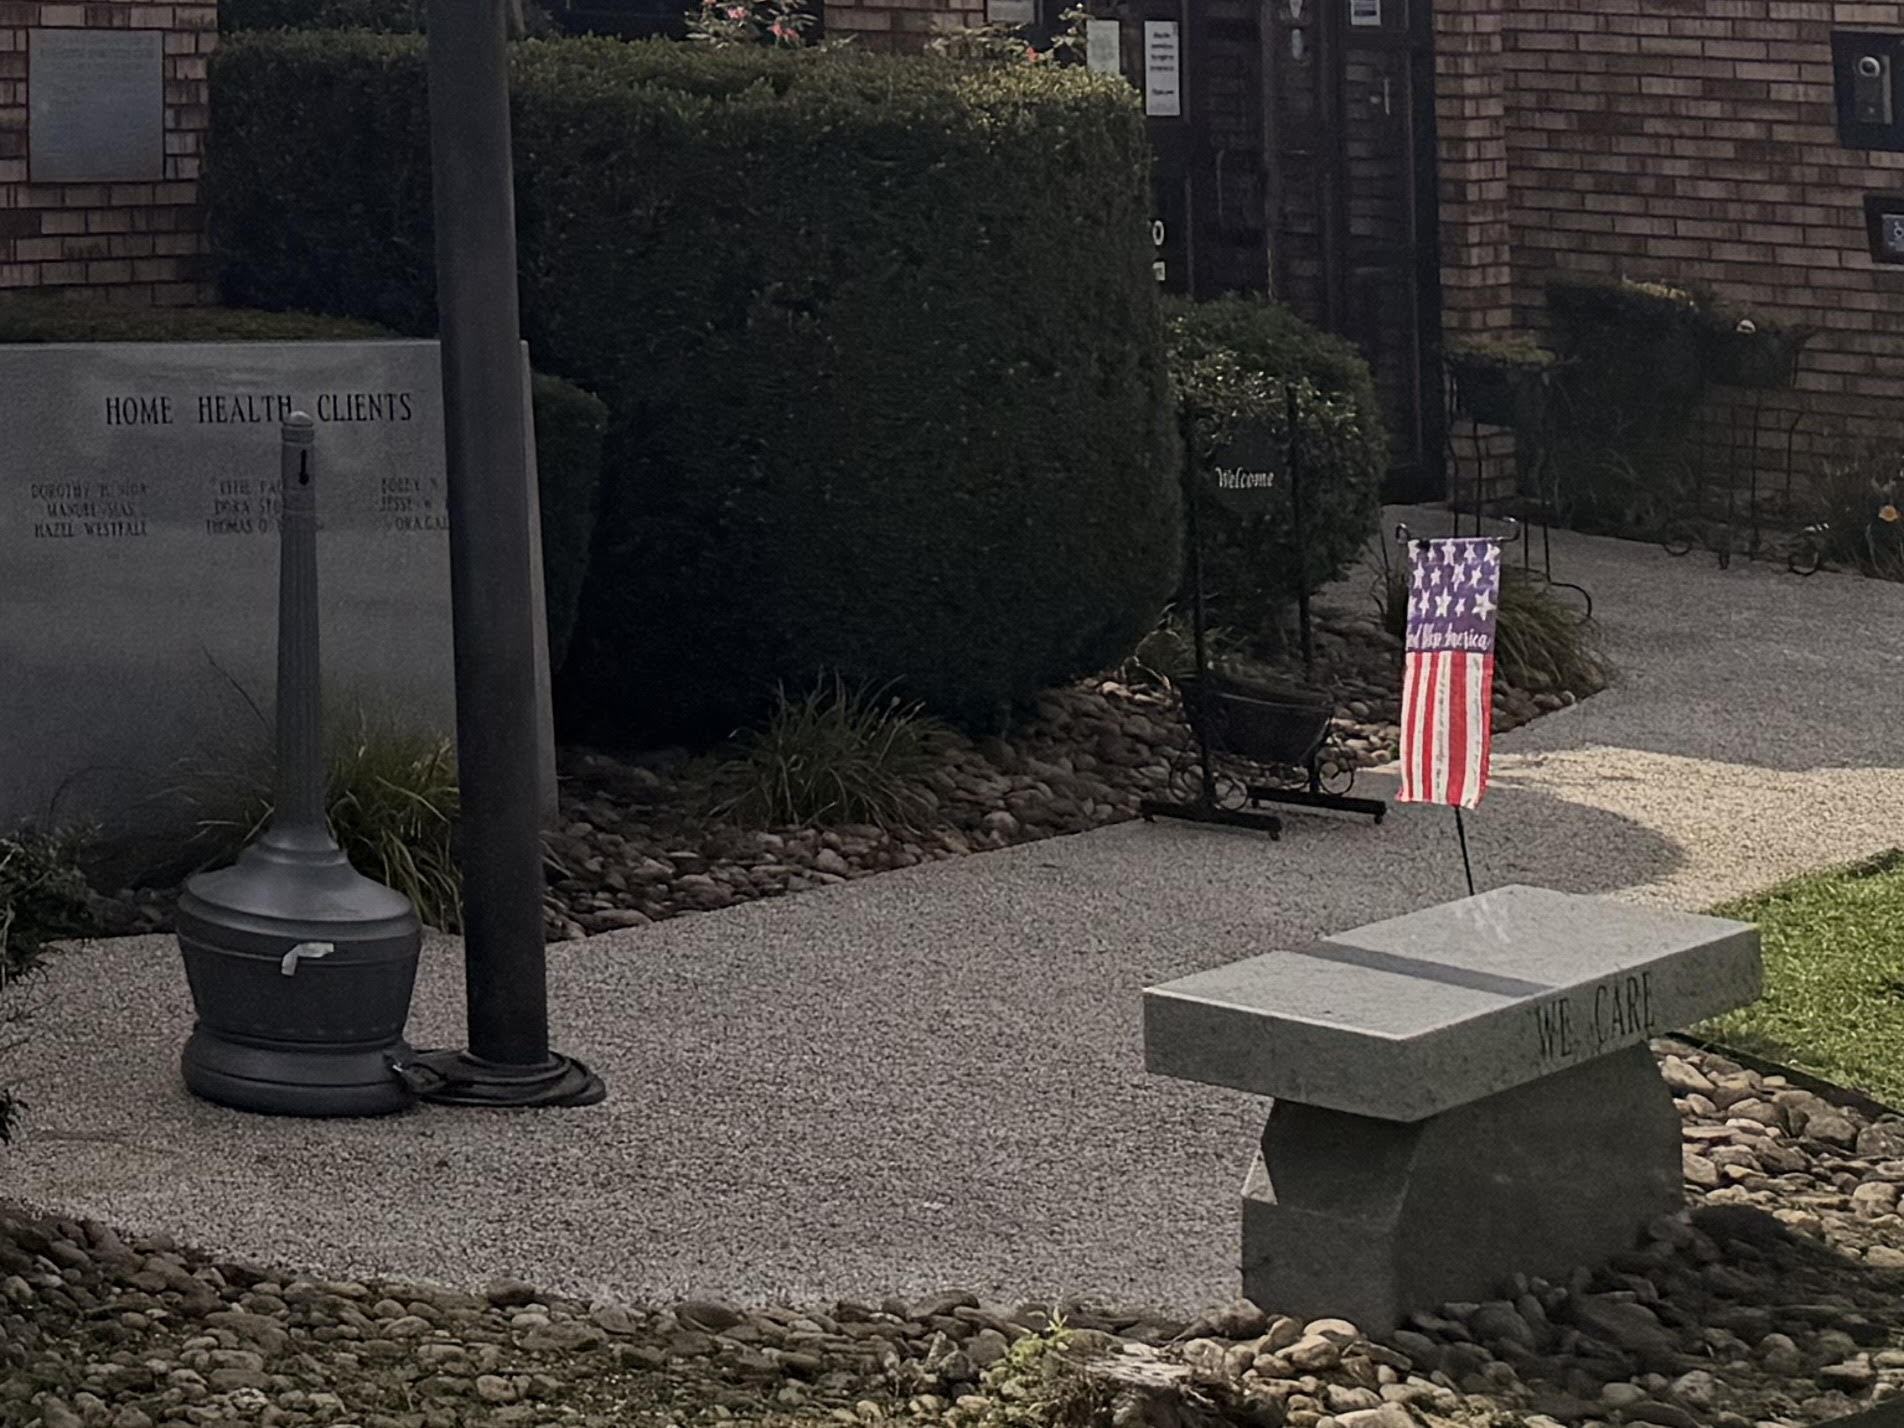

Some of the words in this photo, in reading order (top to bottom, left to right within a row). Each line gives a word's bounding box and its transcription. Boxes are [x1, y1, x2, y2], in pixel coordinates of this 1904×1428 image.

[106, 397, 172, 425] HOME
[199, 395, 291, 424] HEALTH
[317, 393, 412, 421] CLIENTS
[1215, 467, 1275, 489] Welcome
[1442, 622, 1491, 651] America
[1535, 998, 1572, 1059] WE
[1594, 971, 1655, 1045] CARE
